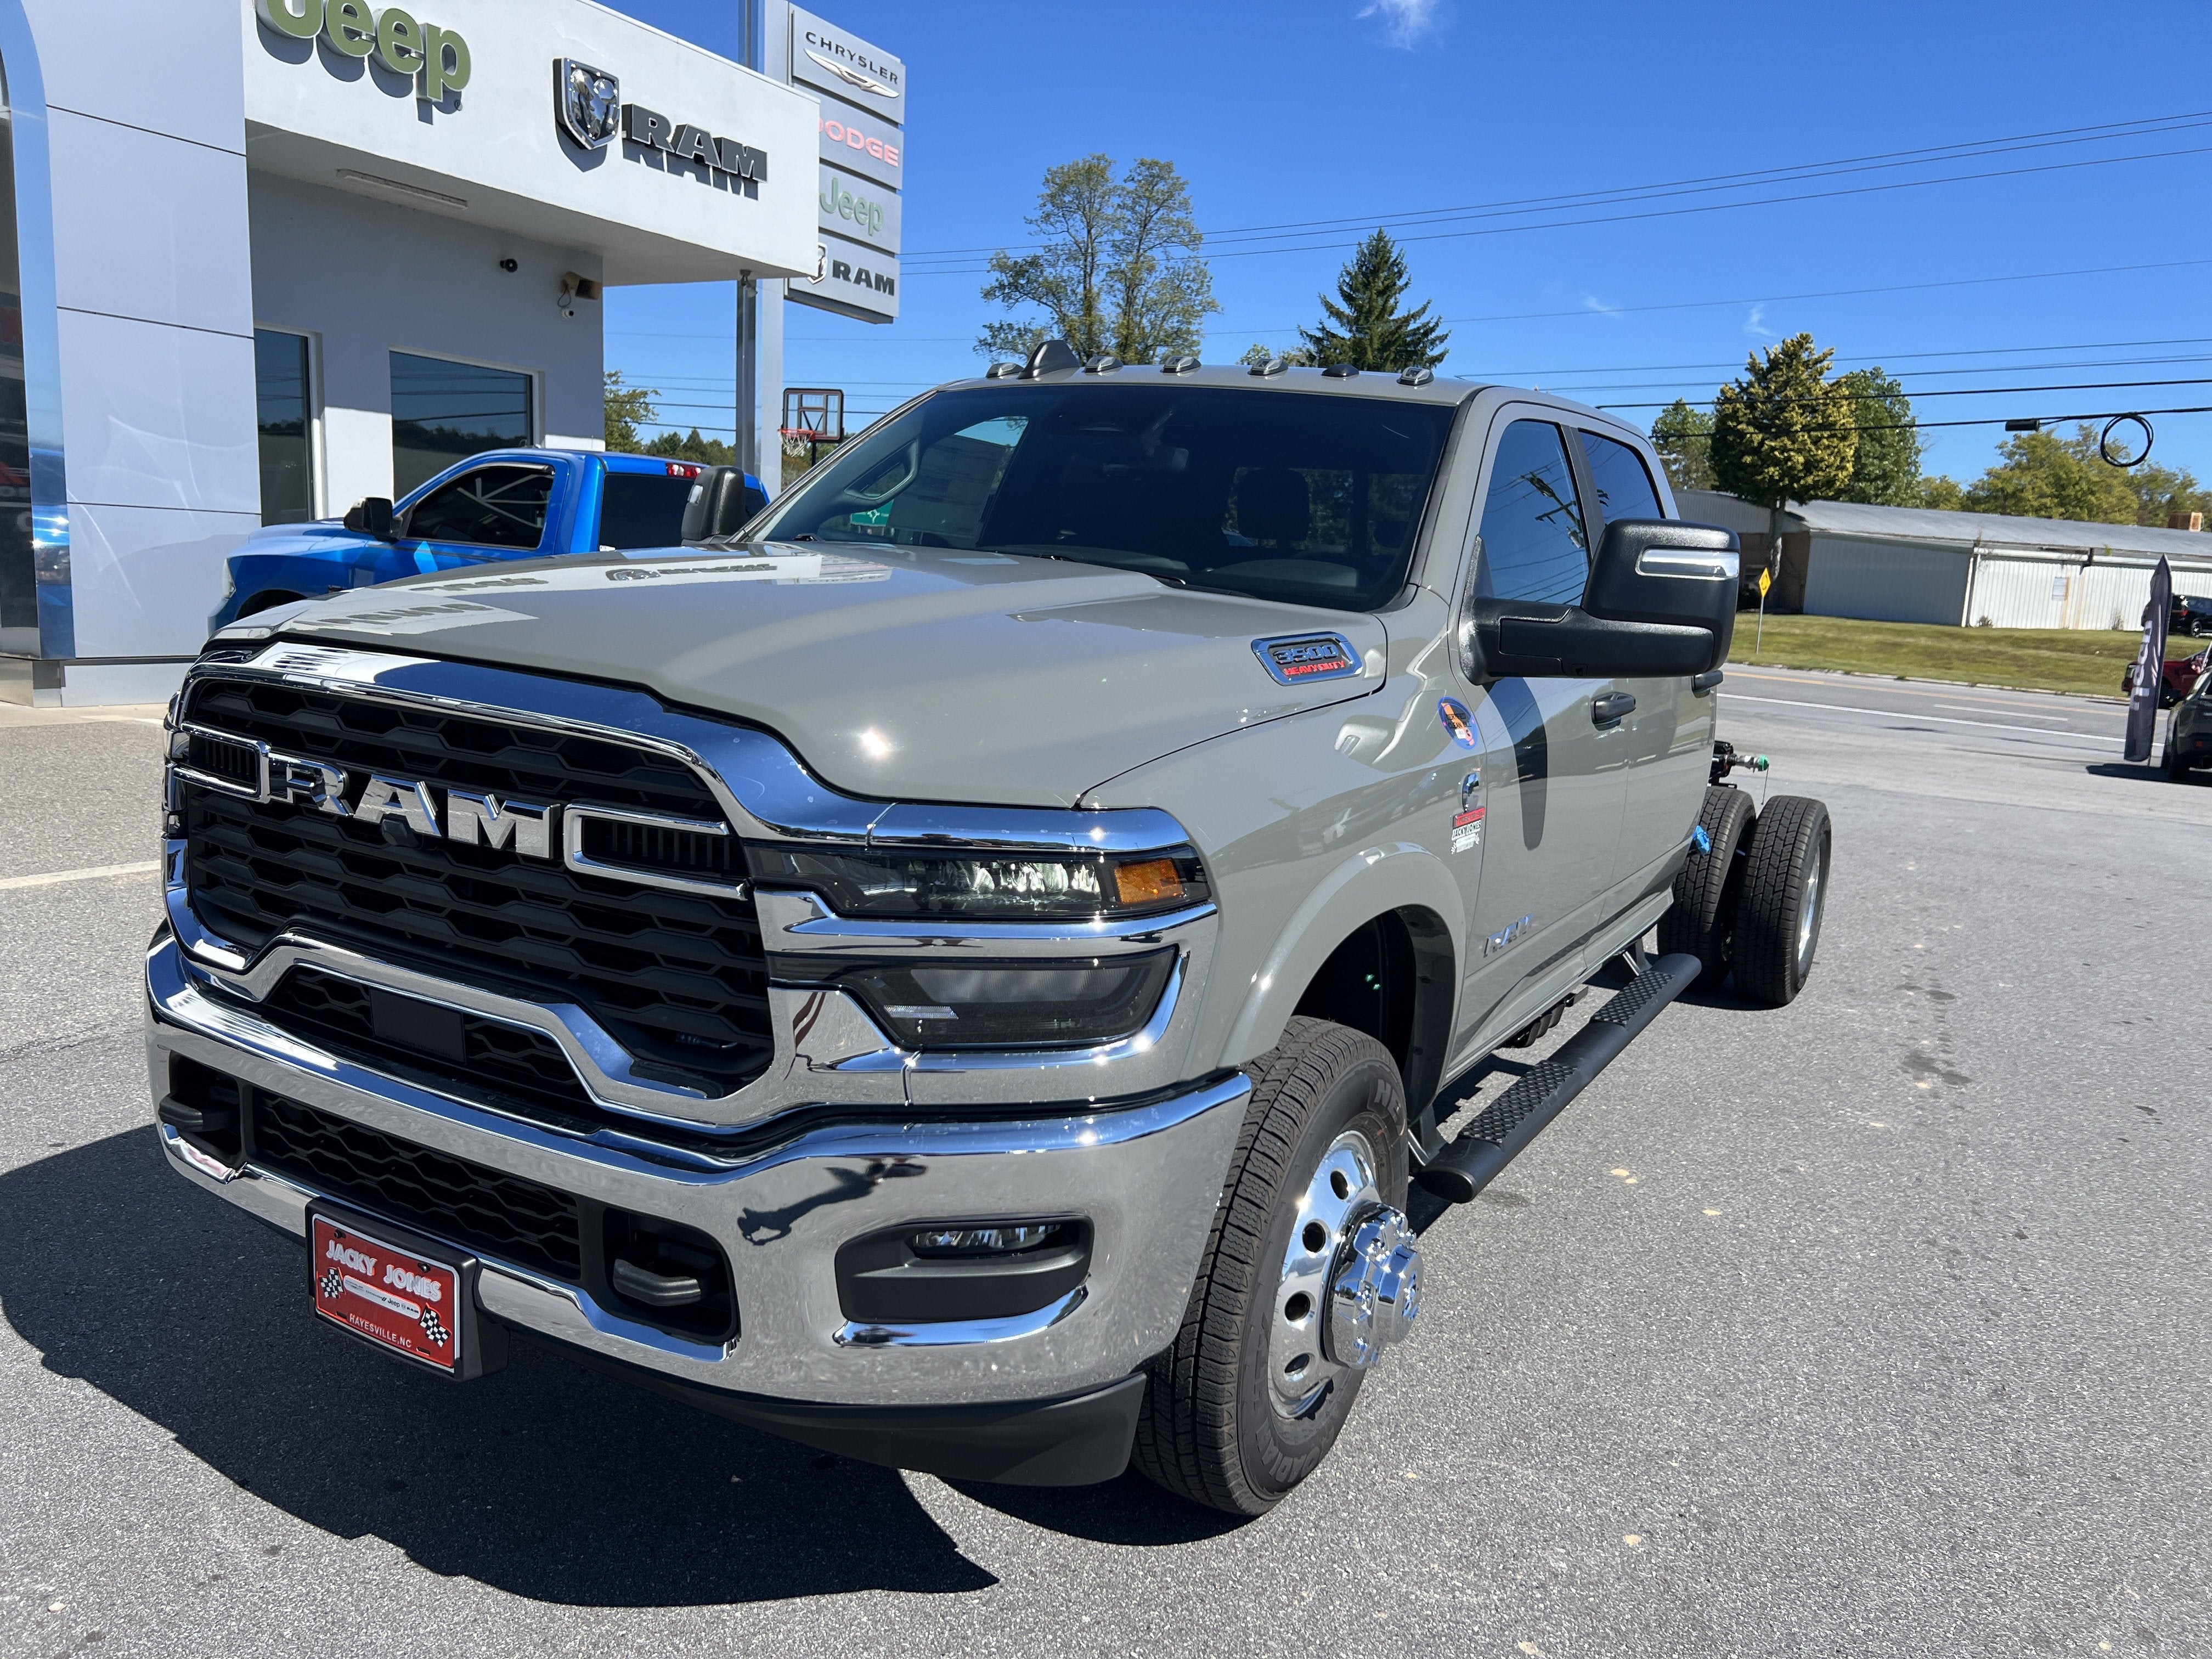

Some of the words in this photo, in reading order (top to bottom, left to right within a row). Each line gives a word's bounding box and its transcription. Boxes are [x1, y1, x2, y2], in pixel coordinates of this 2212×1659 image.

[805, 31, 899, 85] CHRYSLER
[622, 103, 768, 183] RAM
[820, 177, 884, 236] Jeep
[832, 259, 895, 296] RAM
[1273, 644, 1339, 665] 3500
[1283, 664, 1318, 676] HEAVY
[1317, 660, 1345, 671] DUTY
[269, 752, 560, 860] RAM
[326, 1239, 378, 1276] JACKY
[383, 1264, 442, 1302] JONES
